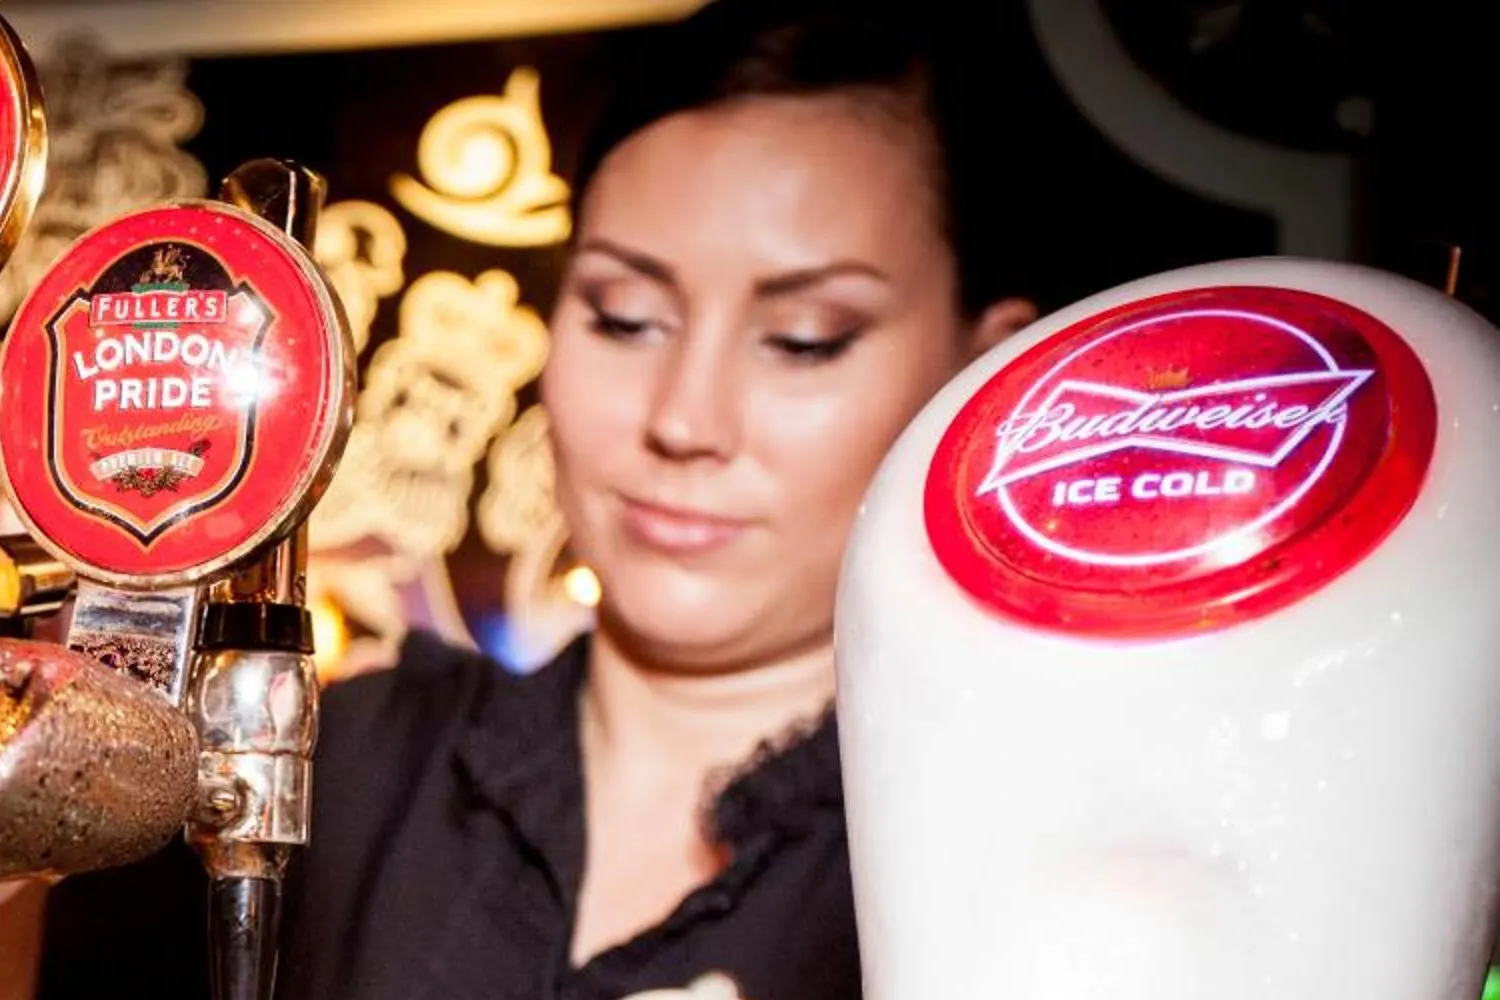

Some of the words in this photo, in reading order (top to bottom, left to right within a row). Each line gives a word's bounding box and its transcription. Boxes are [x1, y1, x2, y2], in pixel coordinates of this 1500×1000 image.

[97, 293, 218, 320] FULLER'S
[94, 376, 213, 411] PRIDE
[80, 412, 224, 449] Outstanding
[996, 394, 1347, 451] Budweiser
[1051, 477, 1122, 507] ICE
[1130, 469, 1257, 499] COLD
